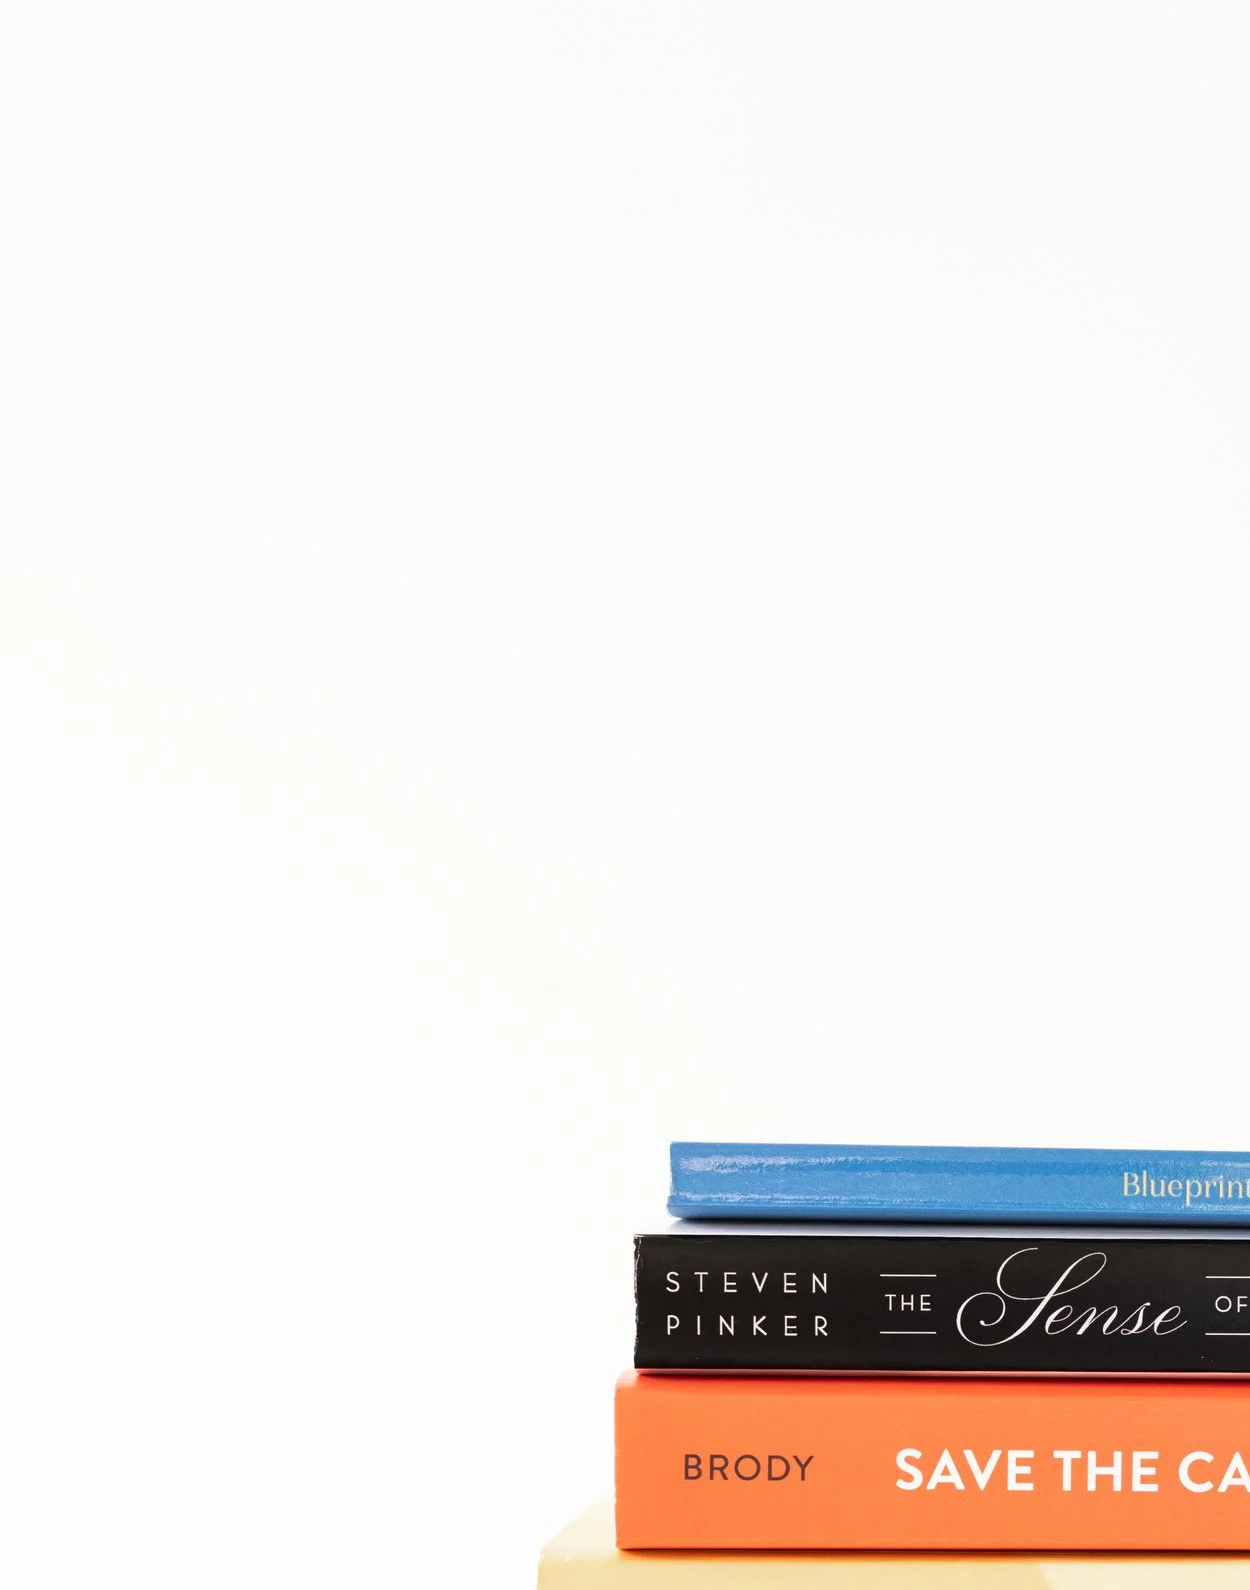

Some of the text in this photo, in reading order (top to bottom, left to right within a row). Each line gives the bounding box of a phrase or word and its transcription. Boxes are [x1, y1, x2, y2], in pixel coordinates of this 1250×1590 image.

[666, 1271, 829, 1294] STEVEN
[884, 1294, 933, 1312] THE
[955, 1247, 1188, 1347] Sense
[1214, 1295, 1249, 1313] OF
[666, 1314, 829, 1337] PINKER
[684, 1453, 815, 1482] BRODY
[895, 1448, 1035, 1491] SAVE
[1053, 1450, 1160, 1492] THE
